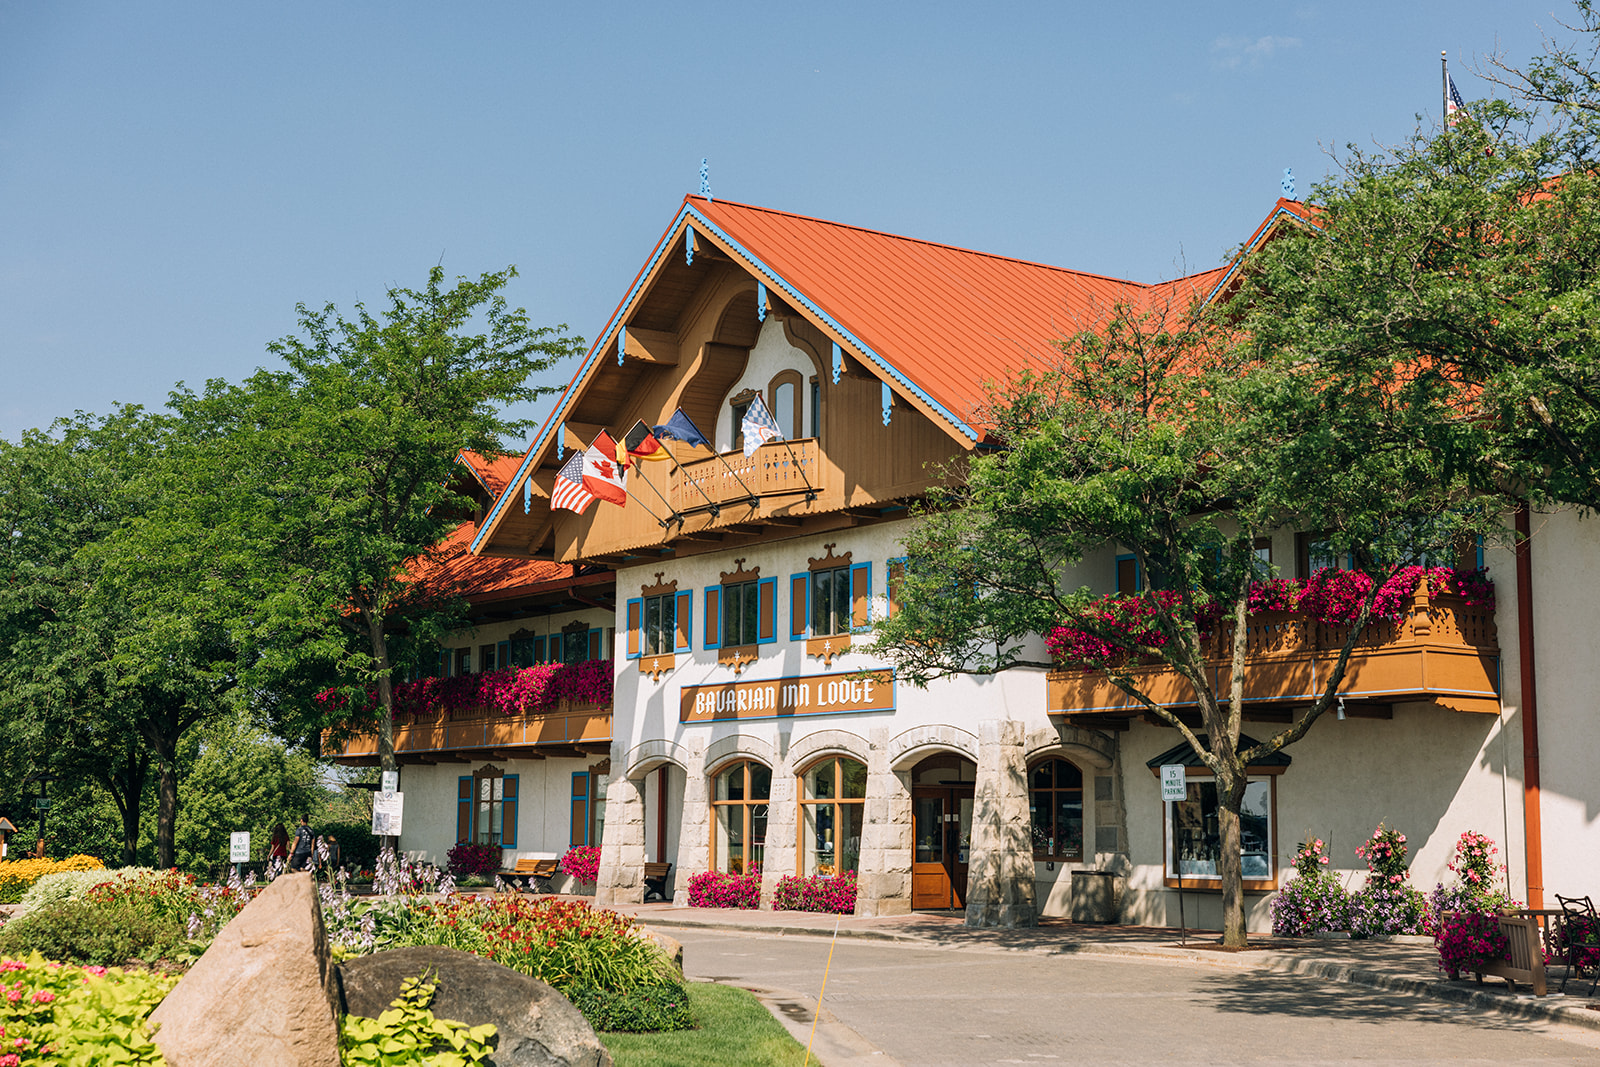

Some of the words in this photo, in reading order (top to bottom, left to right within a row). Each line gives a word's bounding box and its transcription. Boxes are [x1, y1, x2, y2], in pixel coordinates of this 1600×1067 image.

[695, 685, 775, 715] BAVARIAN
[782, 683, 810, 709] INN
[817, 678, 874, 706] LODGE
[1169, 770, 1177, 778] 15
[1165, 779, 1182, 787] MINUTE
[1164, 787, 1184, 795] PARKING
[237, 836, 243, 844] 15
